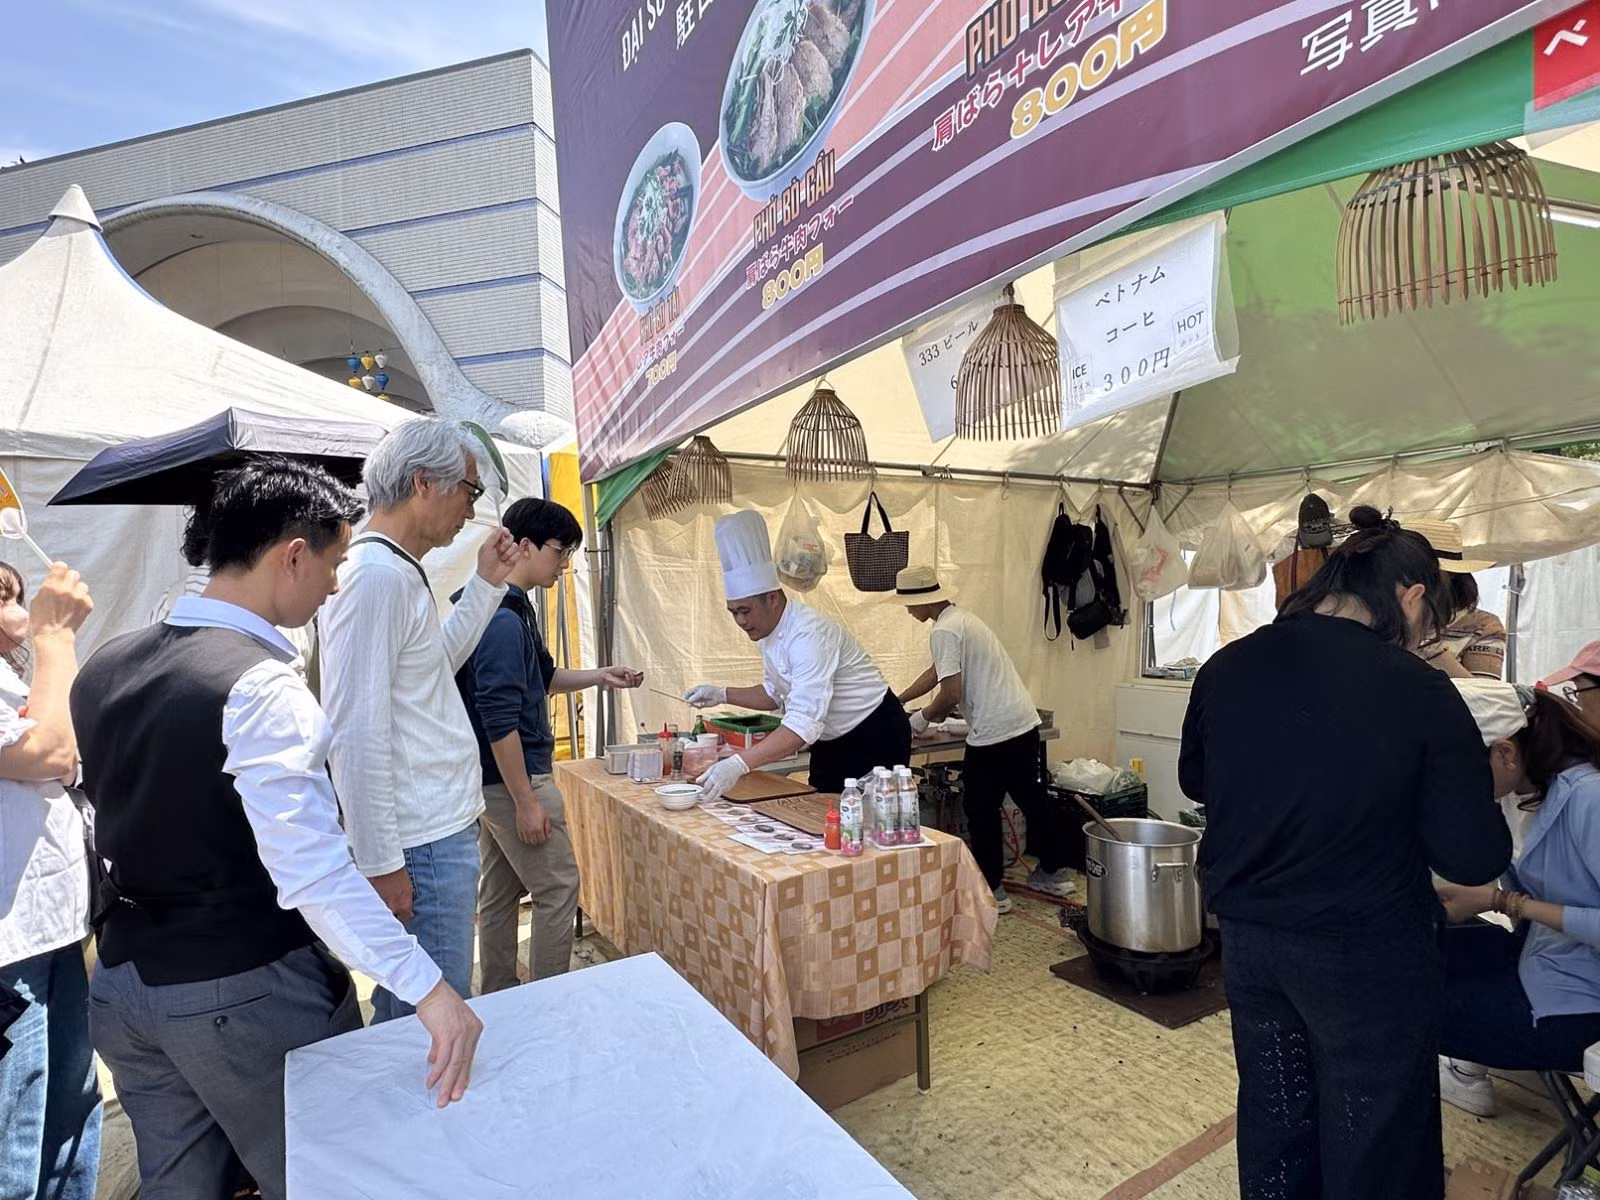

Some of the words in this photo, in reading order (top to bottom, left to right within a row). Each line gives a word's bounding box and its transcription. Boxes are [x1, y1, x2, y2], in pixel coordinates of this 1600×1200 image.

[1300, 0, 1440, 76] 写真
[1010, 0, 1168, 140] 800円
[761, 242, 824, 310] 800円
[1095, 265, 1167, 308] ベトナム
[918, 343, 941, 367] 333
[943, 320, 980, 351] ビール
[1176, 310, 1204, 334] HOT
[1072, 363, 1087, 380] ICE
